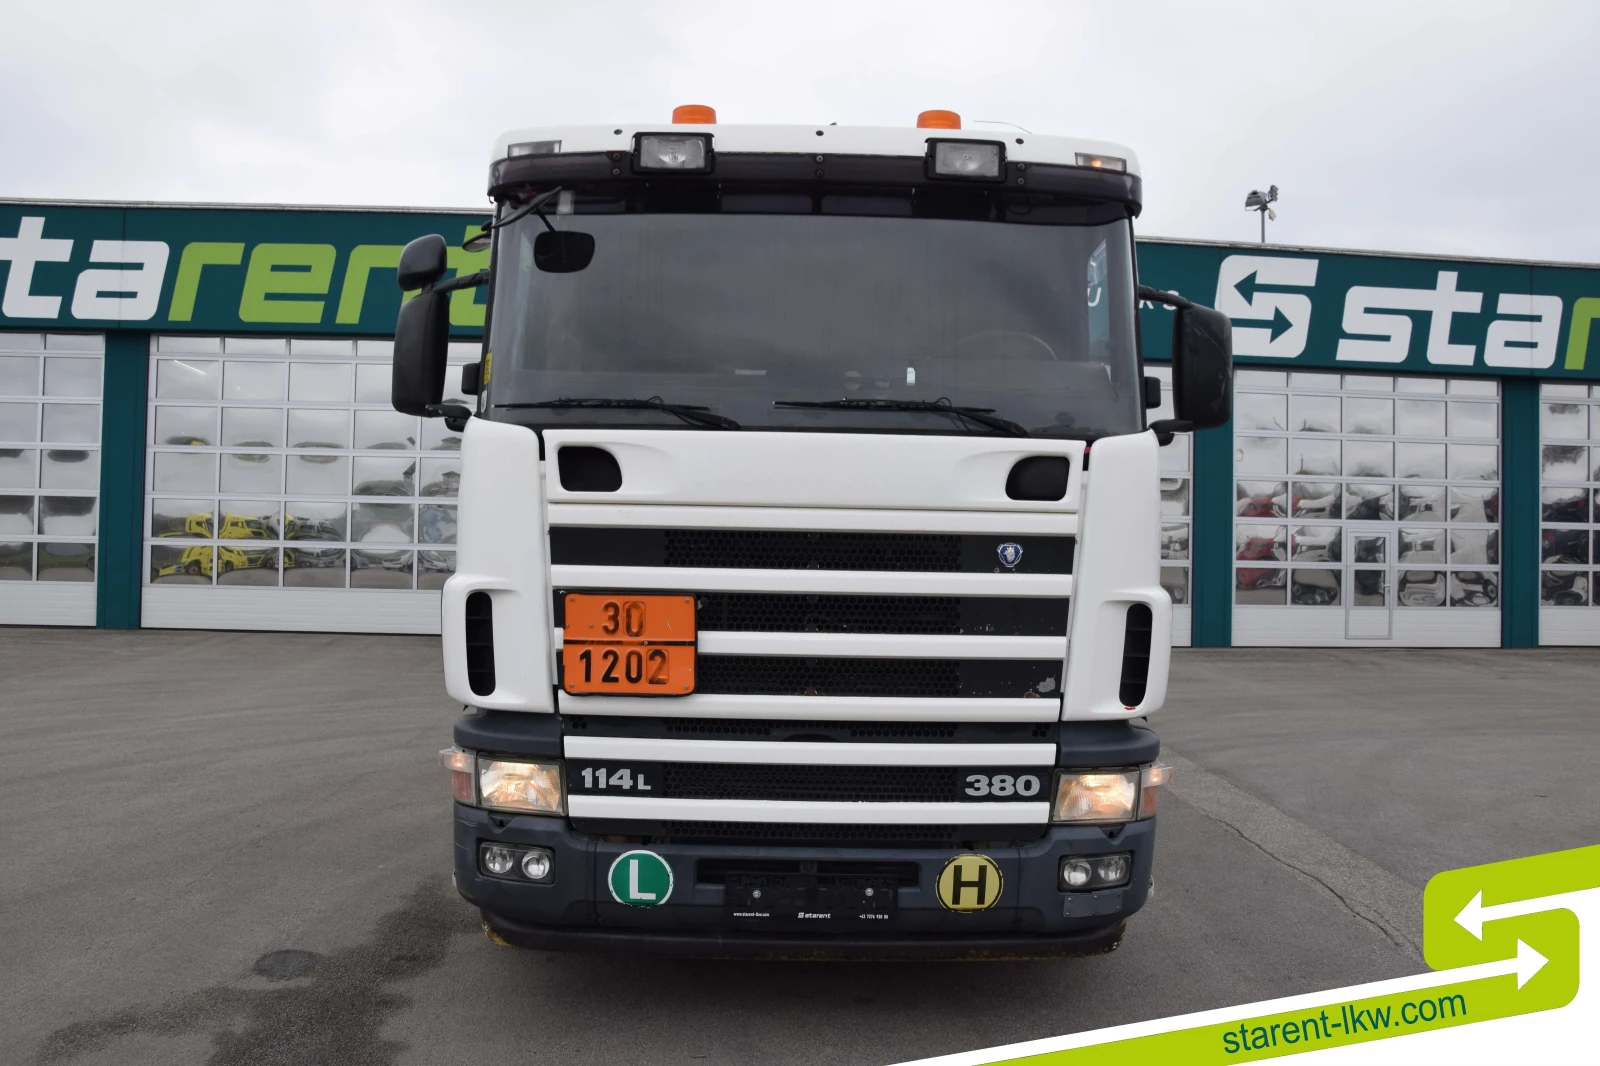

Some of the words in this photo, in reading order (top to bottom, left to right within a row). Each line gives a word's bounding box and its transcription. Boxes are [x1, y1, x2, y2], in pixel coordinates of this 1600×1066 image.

[0, 216, 488, 326] tarent
[602, 601, 645, 637] 30
[579, 649, 667, 685] 1202
[964, 774, 1041, 796] 380
[629, 859, 657, 900] L
[951, 864, 988, 906] H
